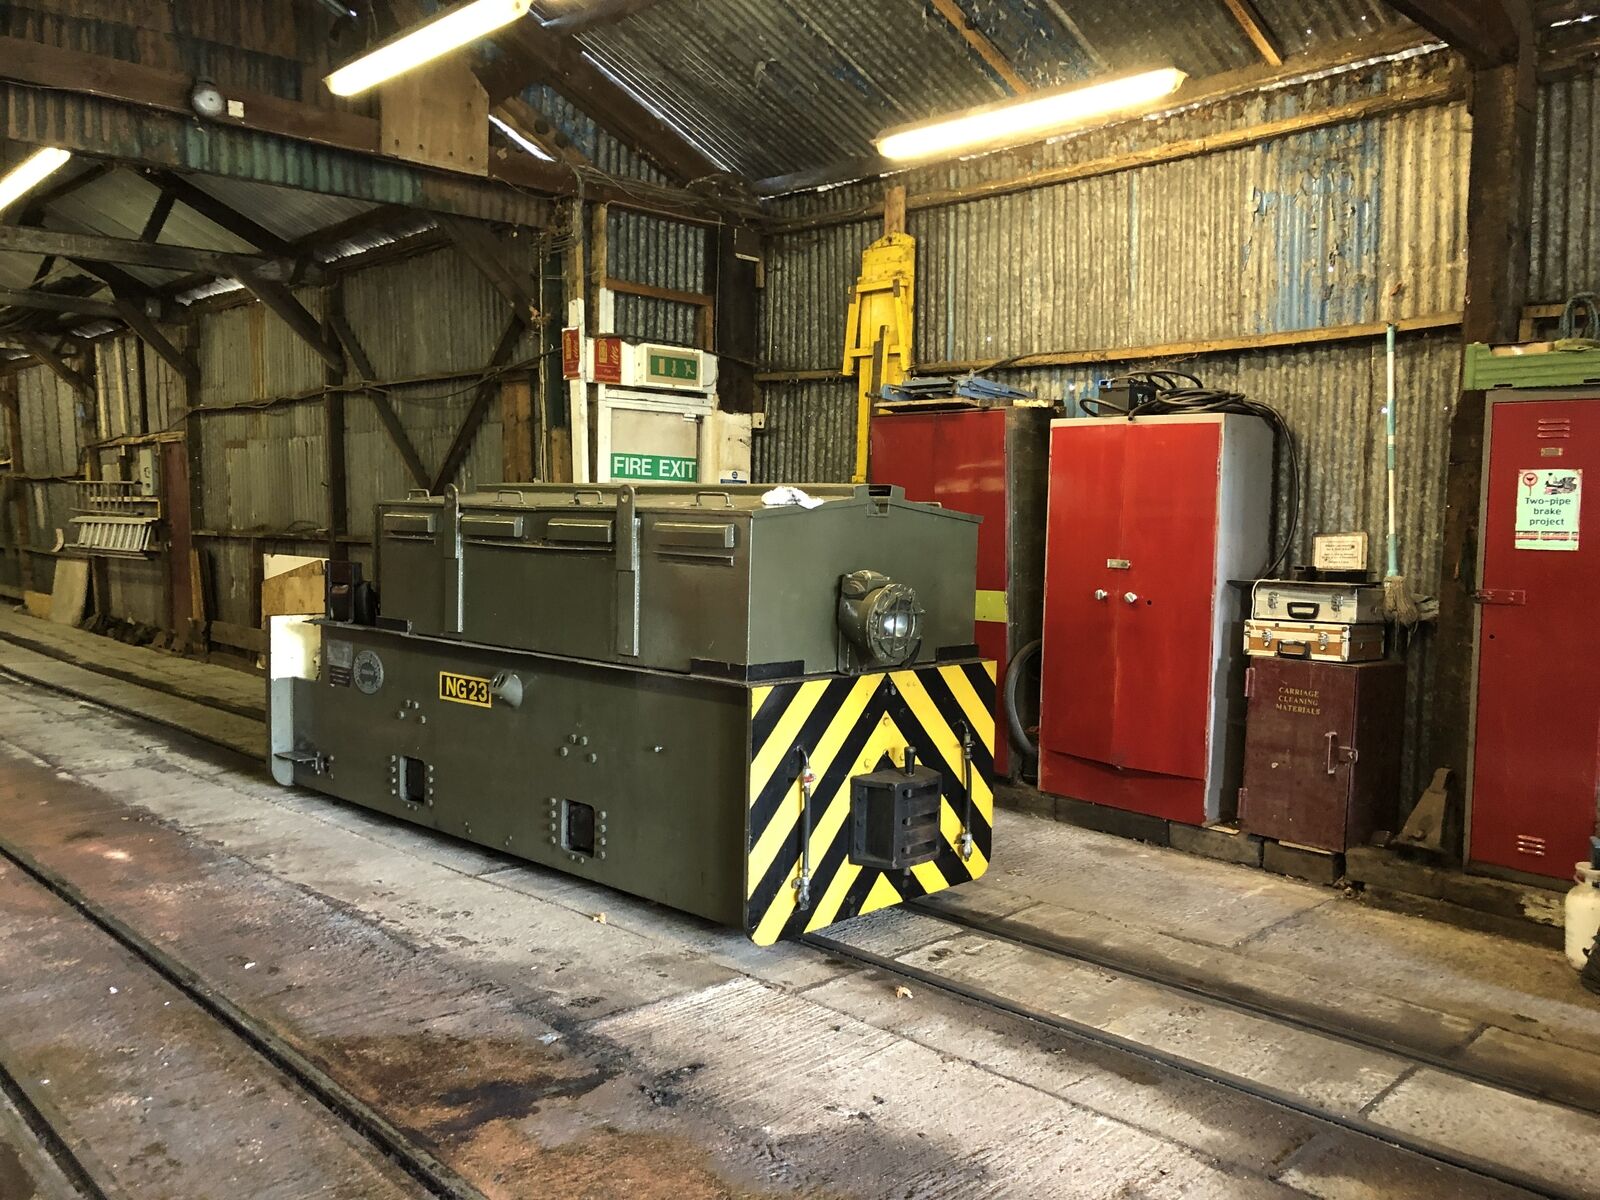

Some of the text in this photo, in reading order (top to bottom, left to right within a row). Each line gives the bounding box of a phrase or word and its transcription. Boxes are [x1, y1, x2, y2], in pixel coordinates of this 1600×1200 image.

[613, 456, 697, 478] FIRE EXIT
[1525, 497, 1571, 506] Two-pipe
[1529, 518, 1565, 527] project
[1278, 686, 1320, 698] CARRIAGE
[1278, 695, 1319, 706] CLEANING
[1275, 703, 1321, 716] MATERIALS
